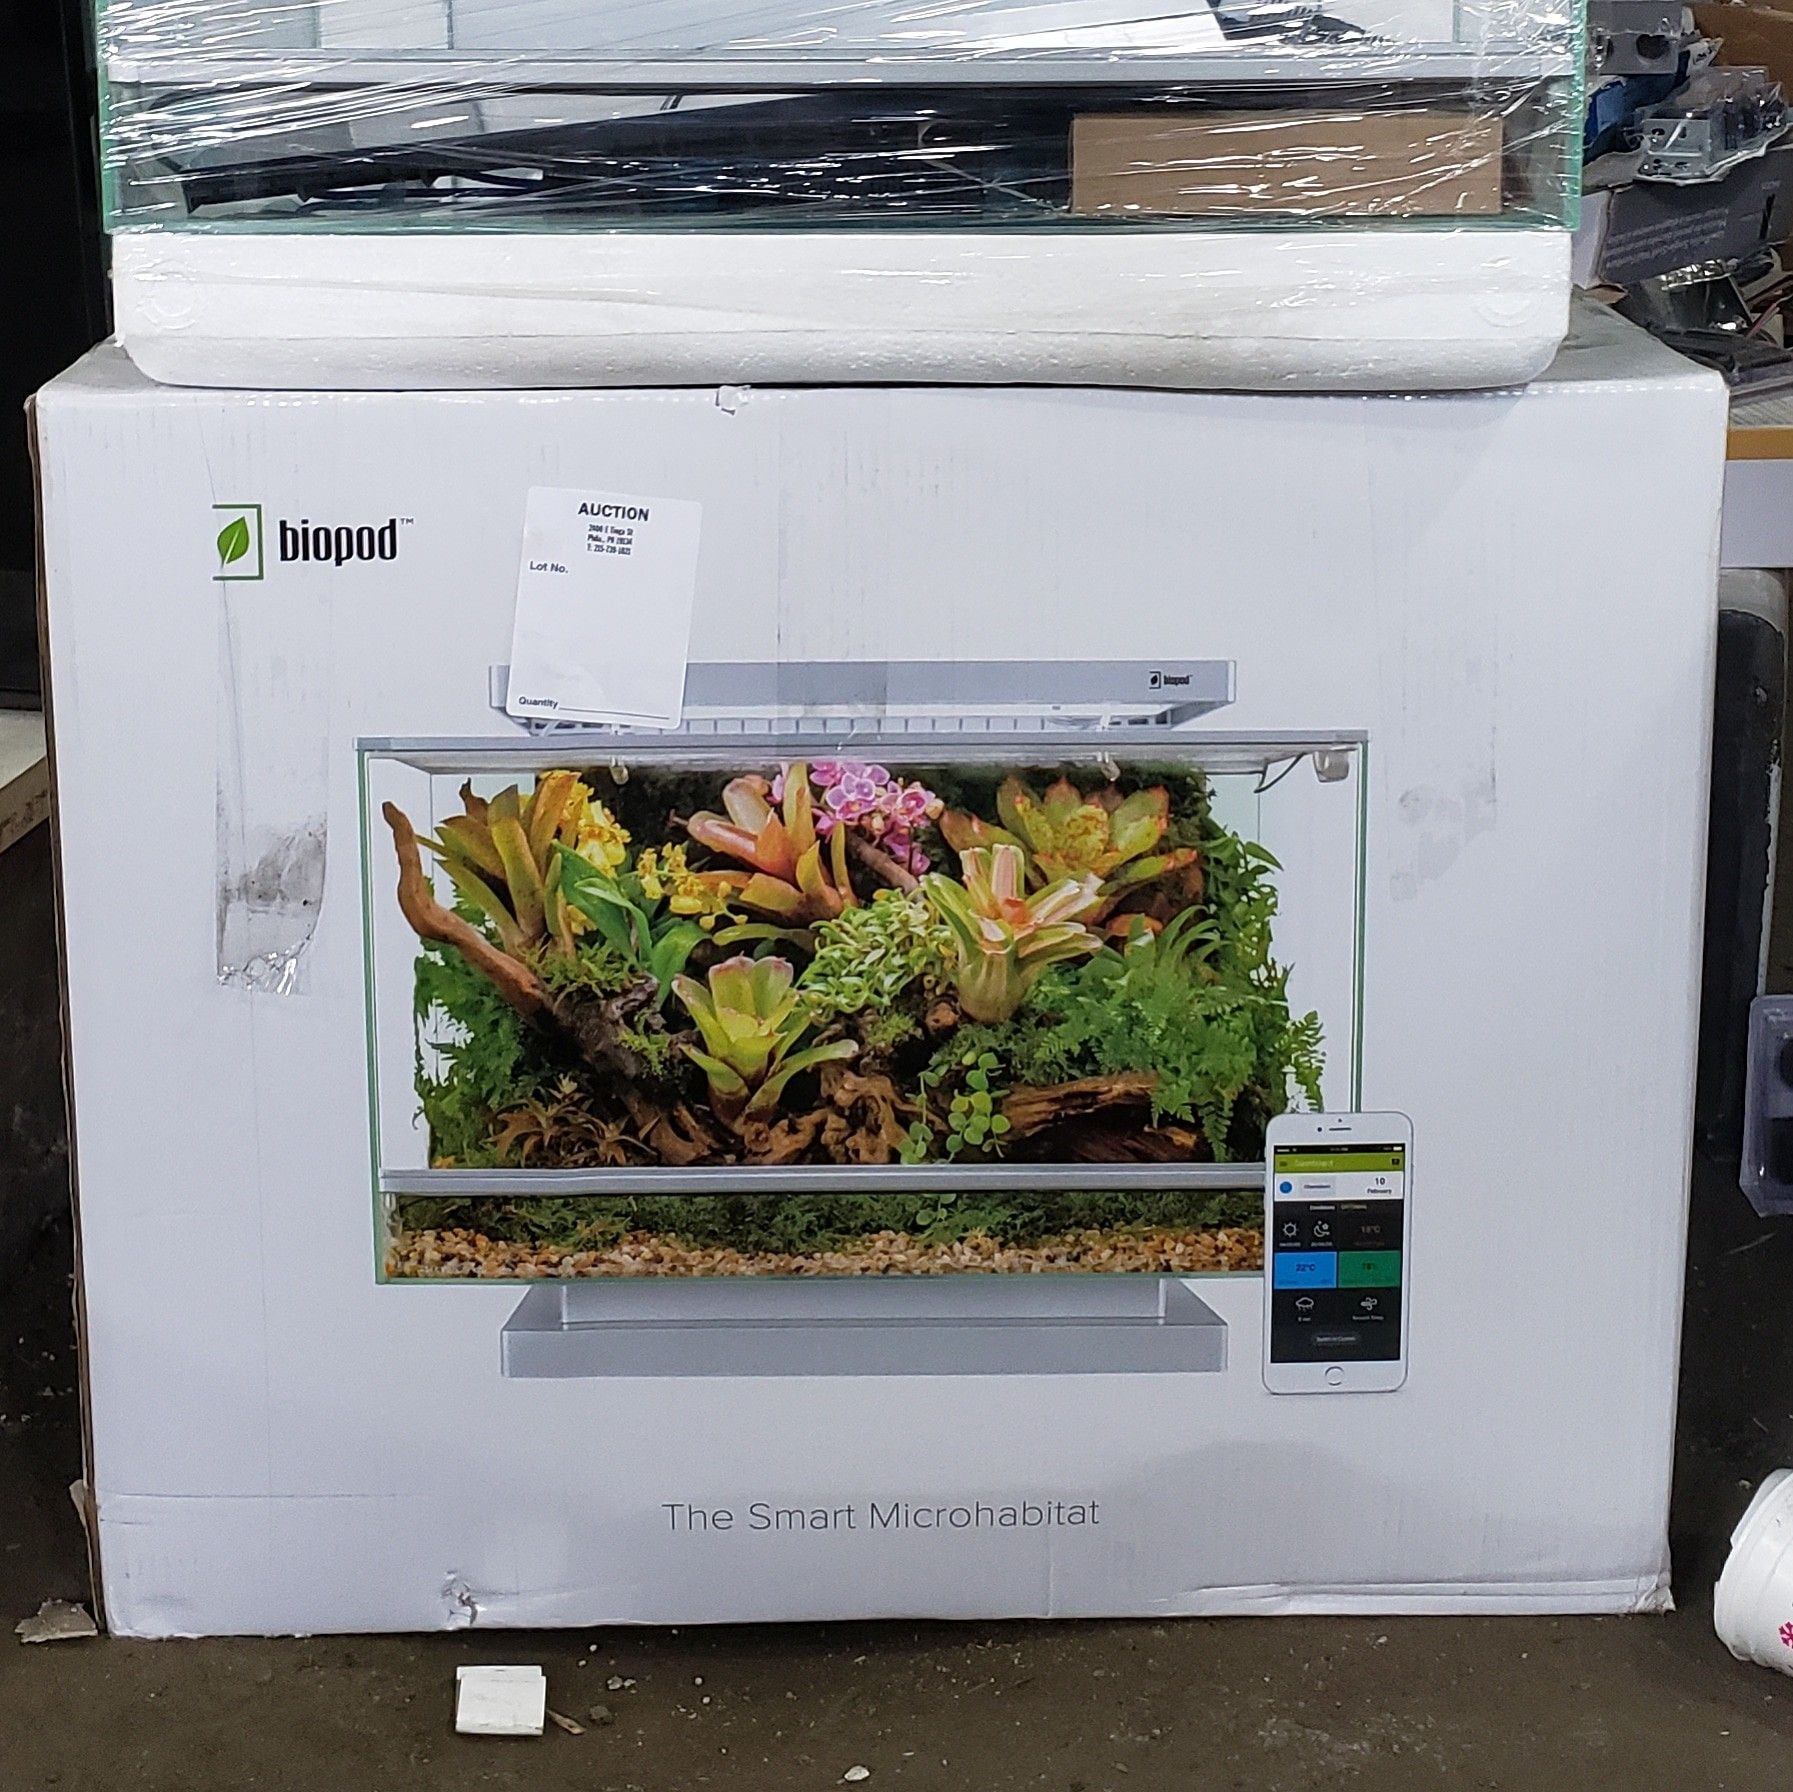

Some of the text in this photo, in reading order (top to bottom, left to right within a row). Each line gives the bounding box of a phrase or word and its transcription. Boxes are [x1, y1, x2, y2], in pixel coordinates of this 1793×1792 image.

[577, 502, 650, 522] AUCTION
[279, 518, 397, 566] biopod
[530, 560, 569, 574] Lot No.
[518, 696, 559, 710] Quantity
[1375, 1177, 1387, 1186] 10
[1295, 1263, 1317, 1273] 22°C
[662, 1499, 1100, 1531] The Smart Microhabitat
